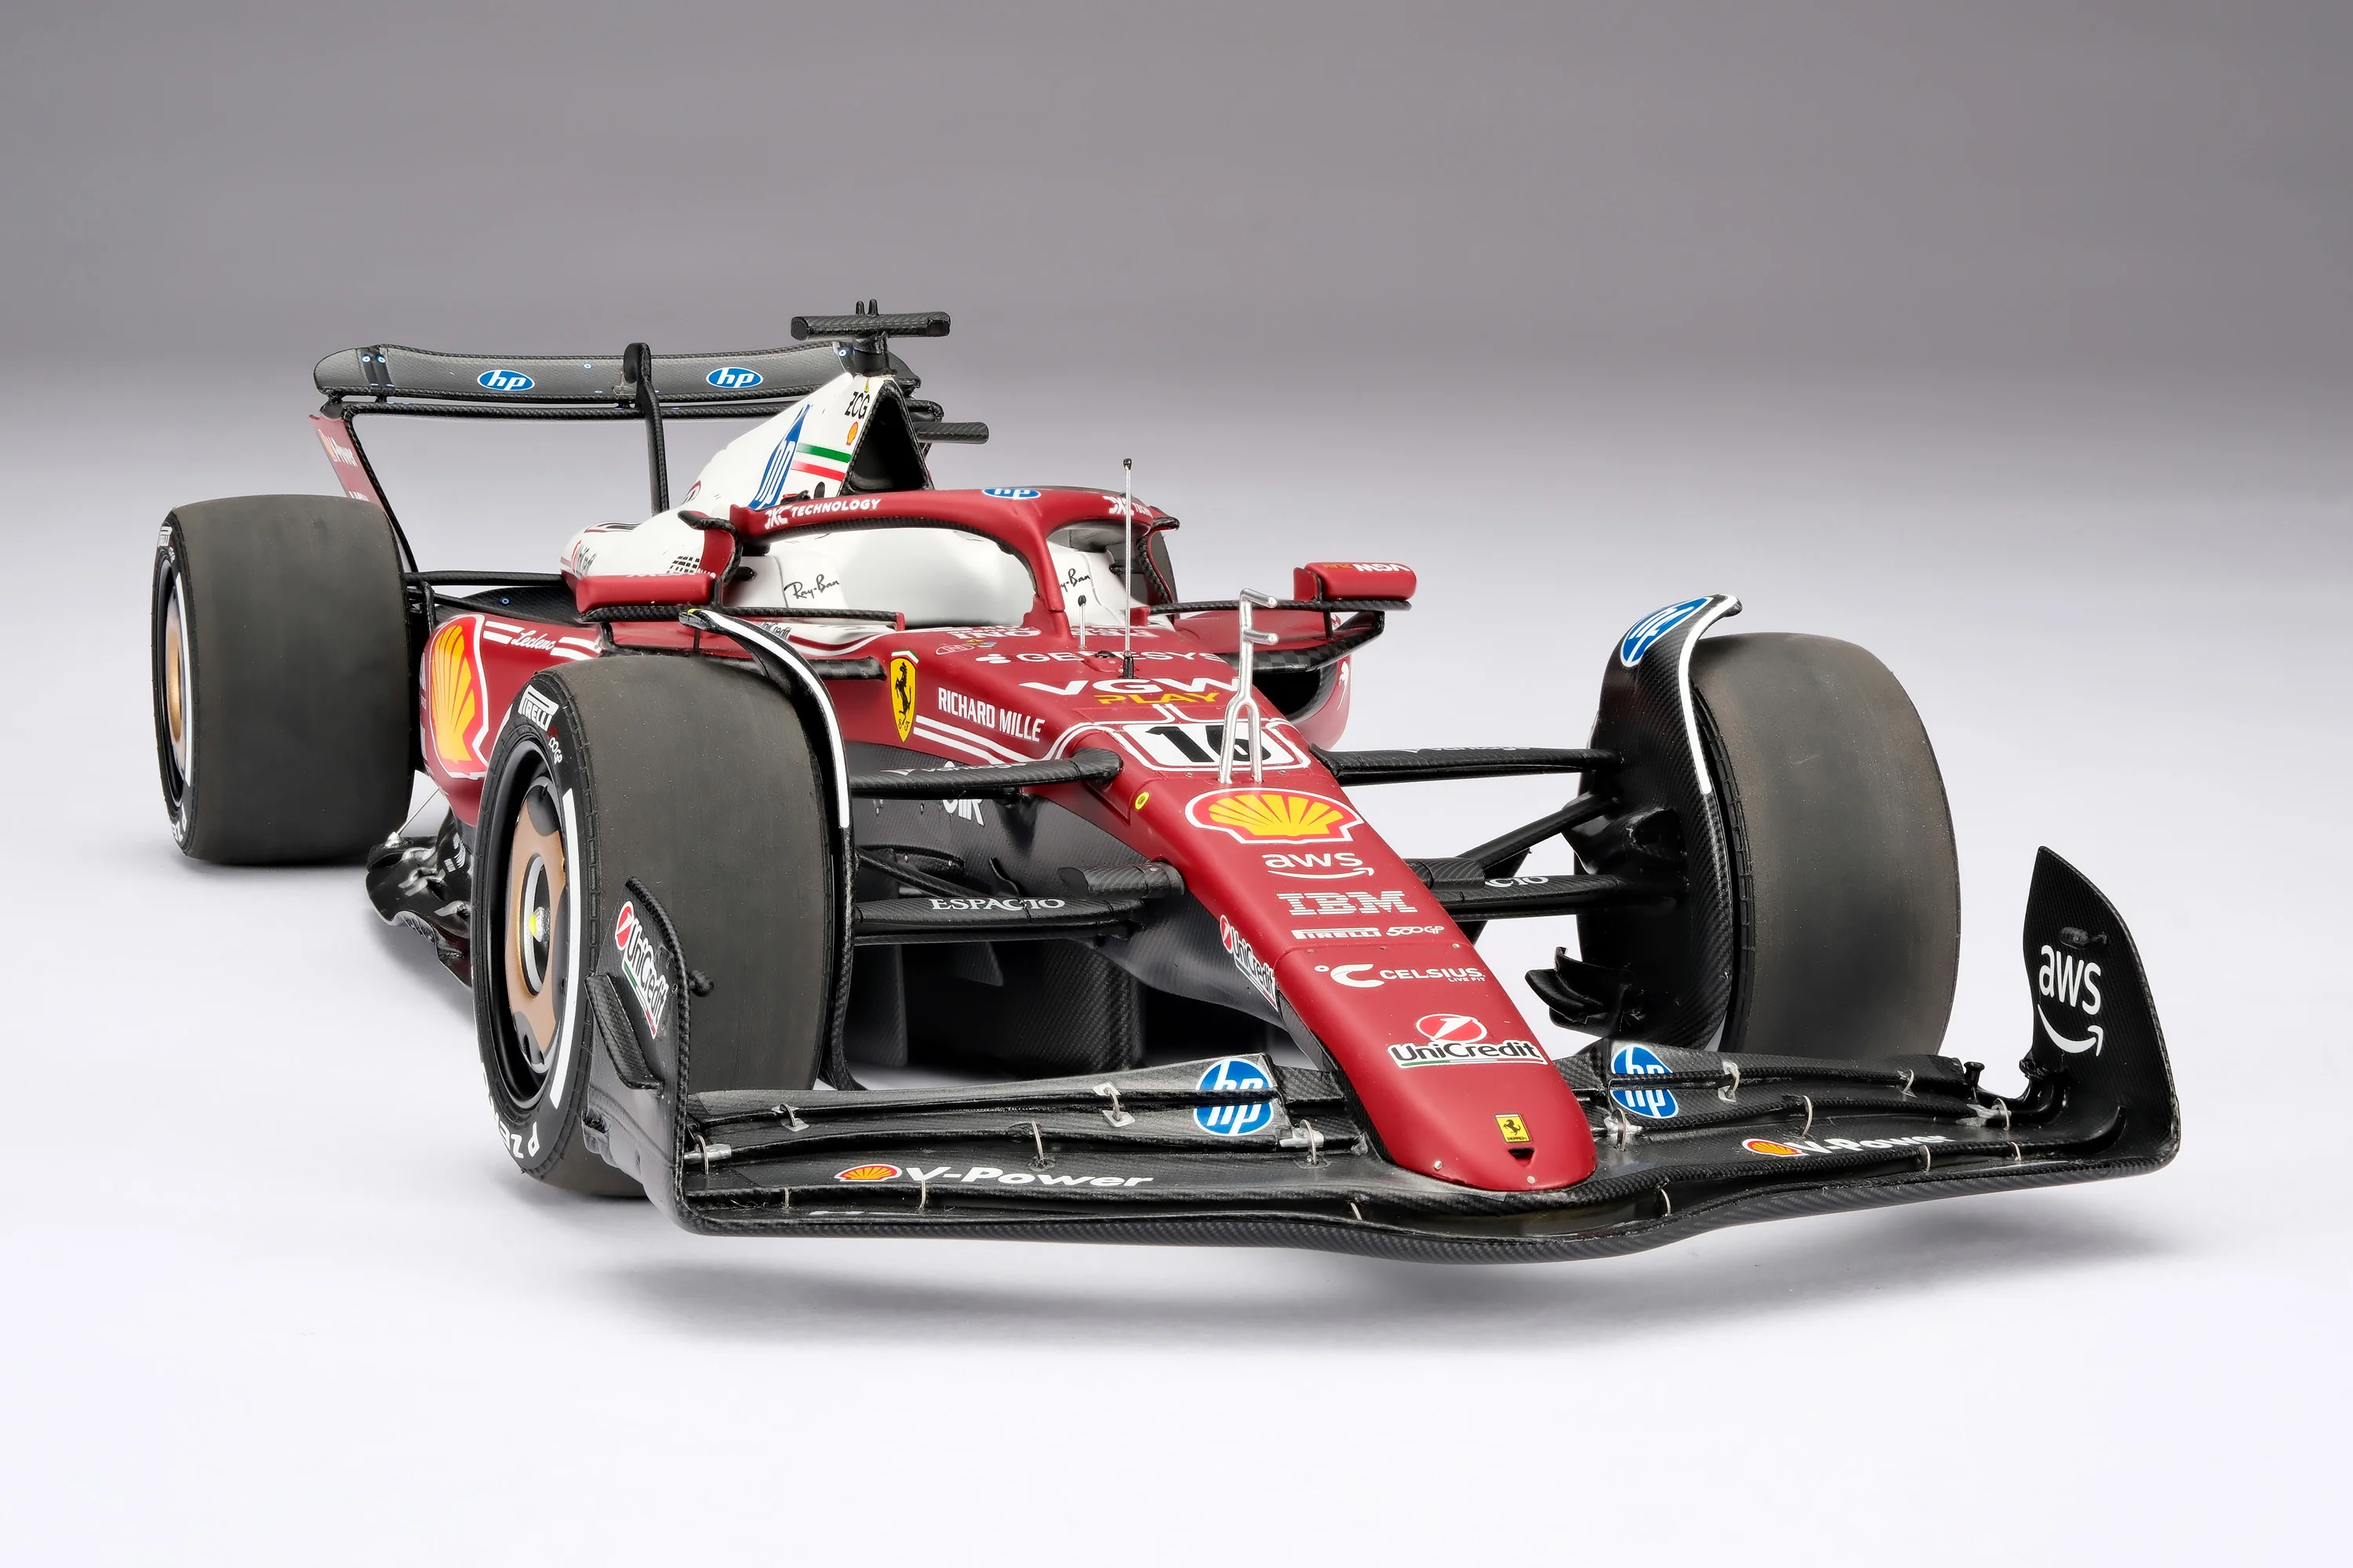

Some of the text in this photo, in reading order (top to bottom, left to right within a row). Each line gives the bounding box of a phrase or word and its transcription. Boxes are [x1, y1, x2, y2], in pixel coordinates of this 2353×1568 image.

[488, 369, 527, 391] hp
[719, 367, 755, 388] hp
[791, 499, 881, 518] TECHNOLOGY
[784, 573, 840, 599] Ray-Ban
[1018, 677, 1241, 695] VGW
[518, 684, 559, 732] PIRELLI
[1093, 692, 1220, 704] PLAY
[938, 686, 1046, 742] RICHARD MILLE
[1261, 852, 1363, 868] aws
[929, 897, 1066, 911] ESPACIO
[1276, 890, 1418, 915] IBM
[1291, 926, 1382, 940] PIRELLI
[627, 919, 668, 1025] UniCredit
[1231, 926, 1276, 1002] UniCredit
[1379, 967, 1483, 980] CELSIUS
[2039, 944, 2101, 1015] aws
[1391, 1042, 1540, 1060] UniCredit
[1206, 1058, 1264, 1135] hp
[1783, 1135, 1956, 1154] V-Power
[905, 1166, 1155, 1188] V-Power
